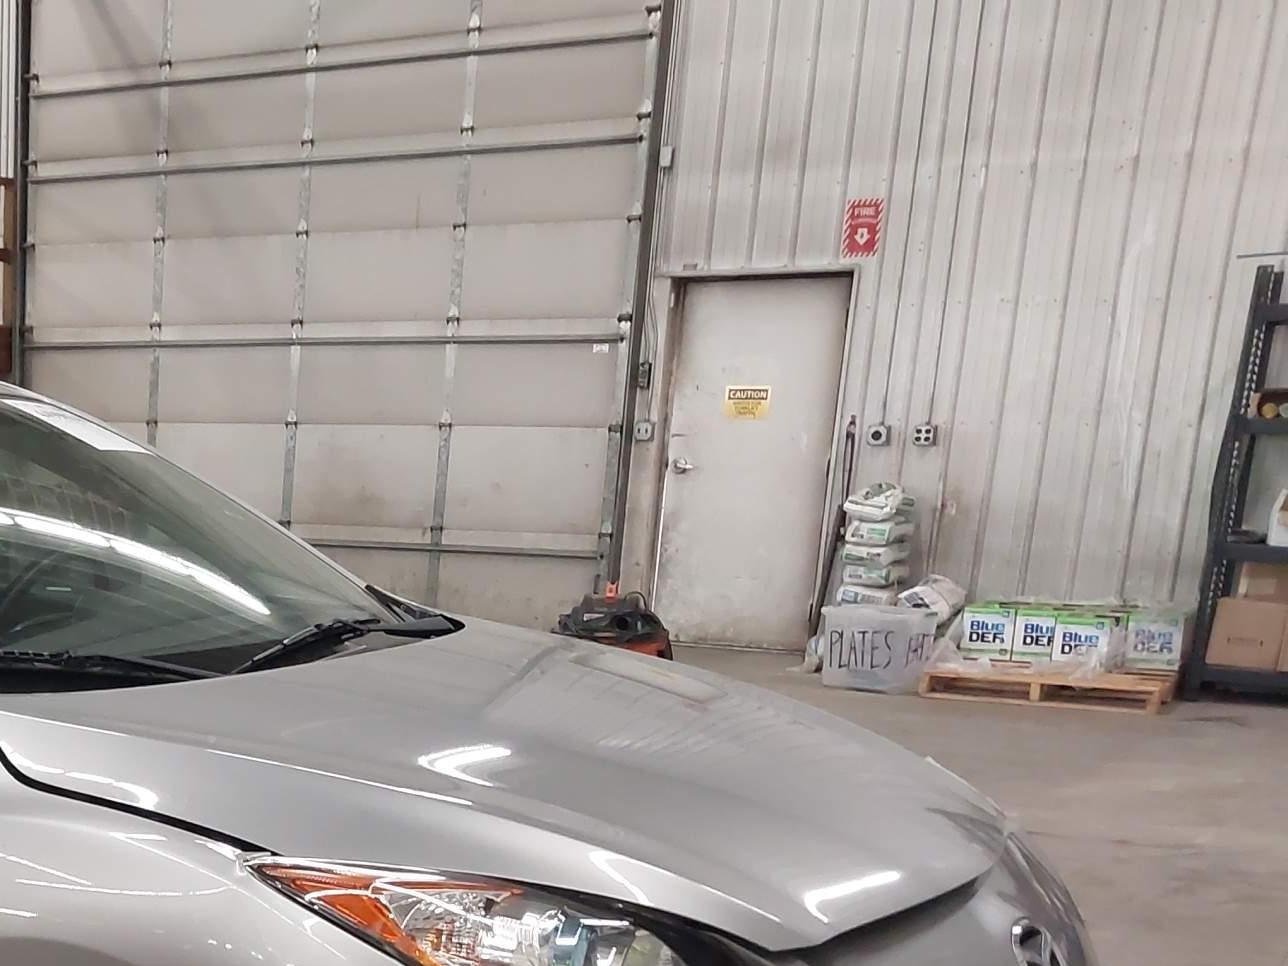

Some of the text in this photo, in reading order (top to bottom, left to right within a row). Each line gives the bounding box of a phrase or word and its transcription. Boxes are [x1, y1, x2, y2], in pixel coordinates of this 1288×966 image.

[729, 390, 767, 399] CAUTION
[970, 620, 1005, 631] Blue
[1062, 632, 1099, 643] Blue
[828, 629, 895, 671] PLATES
